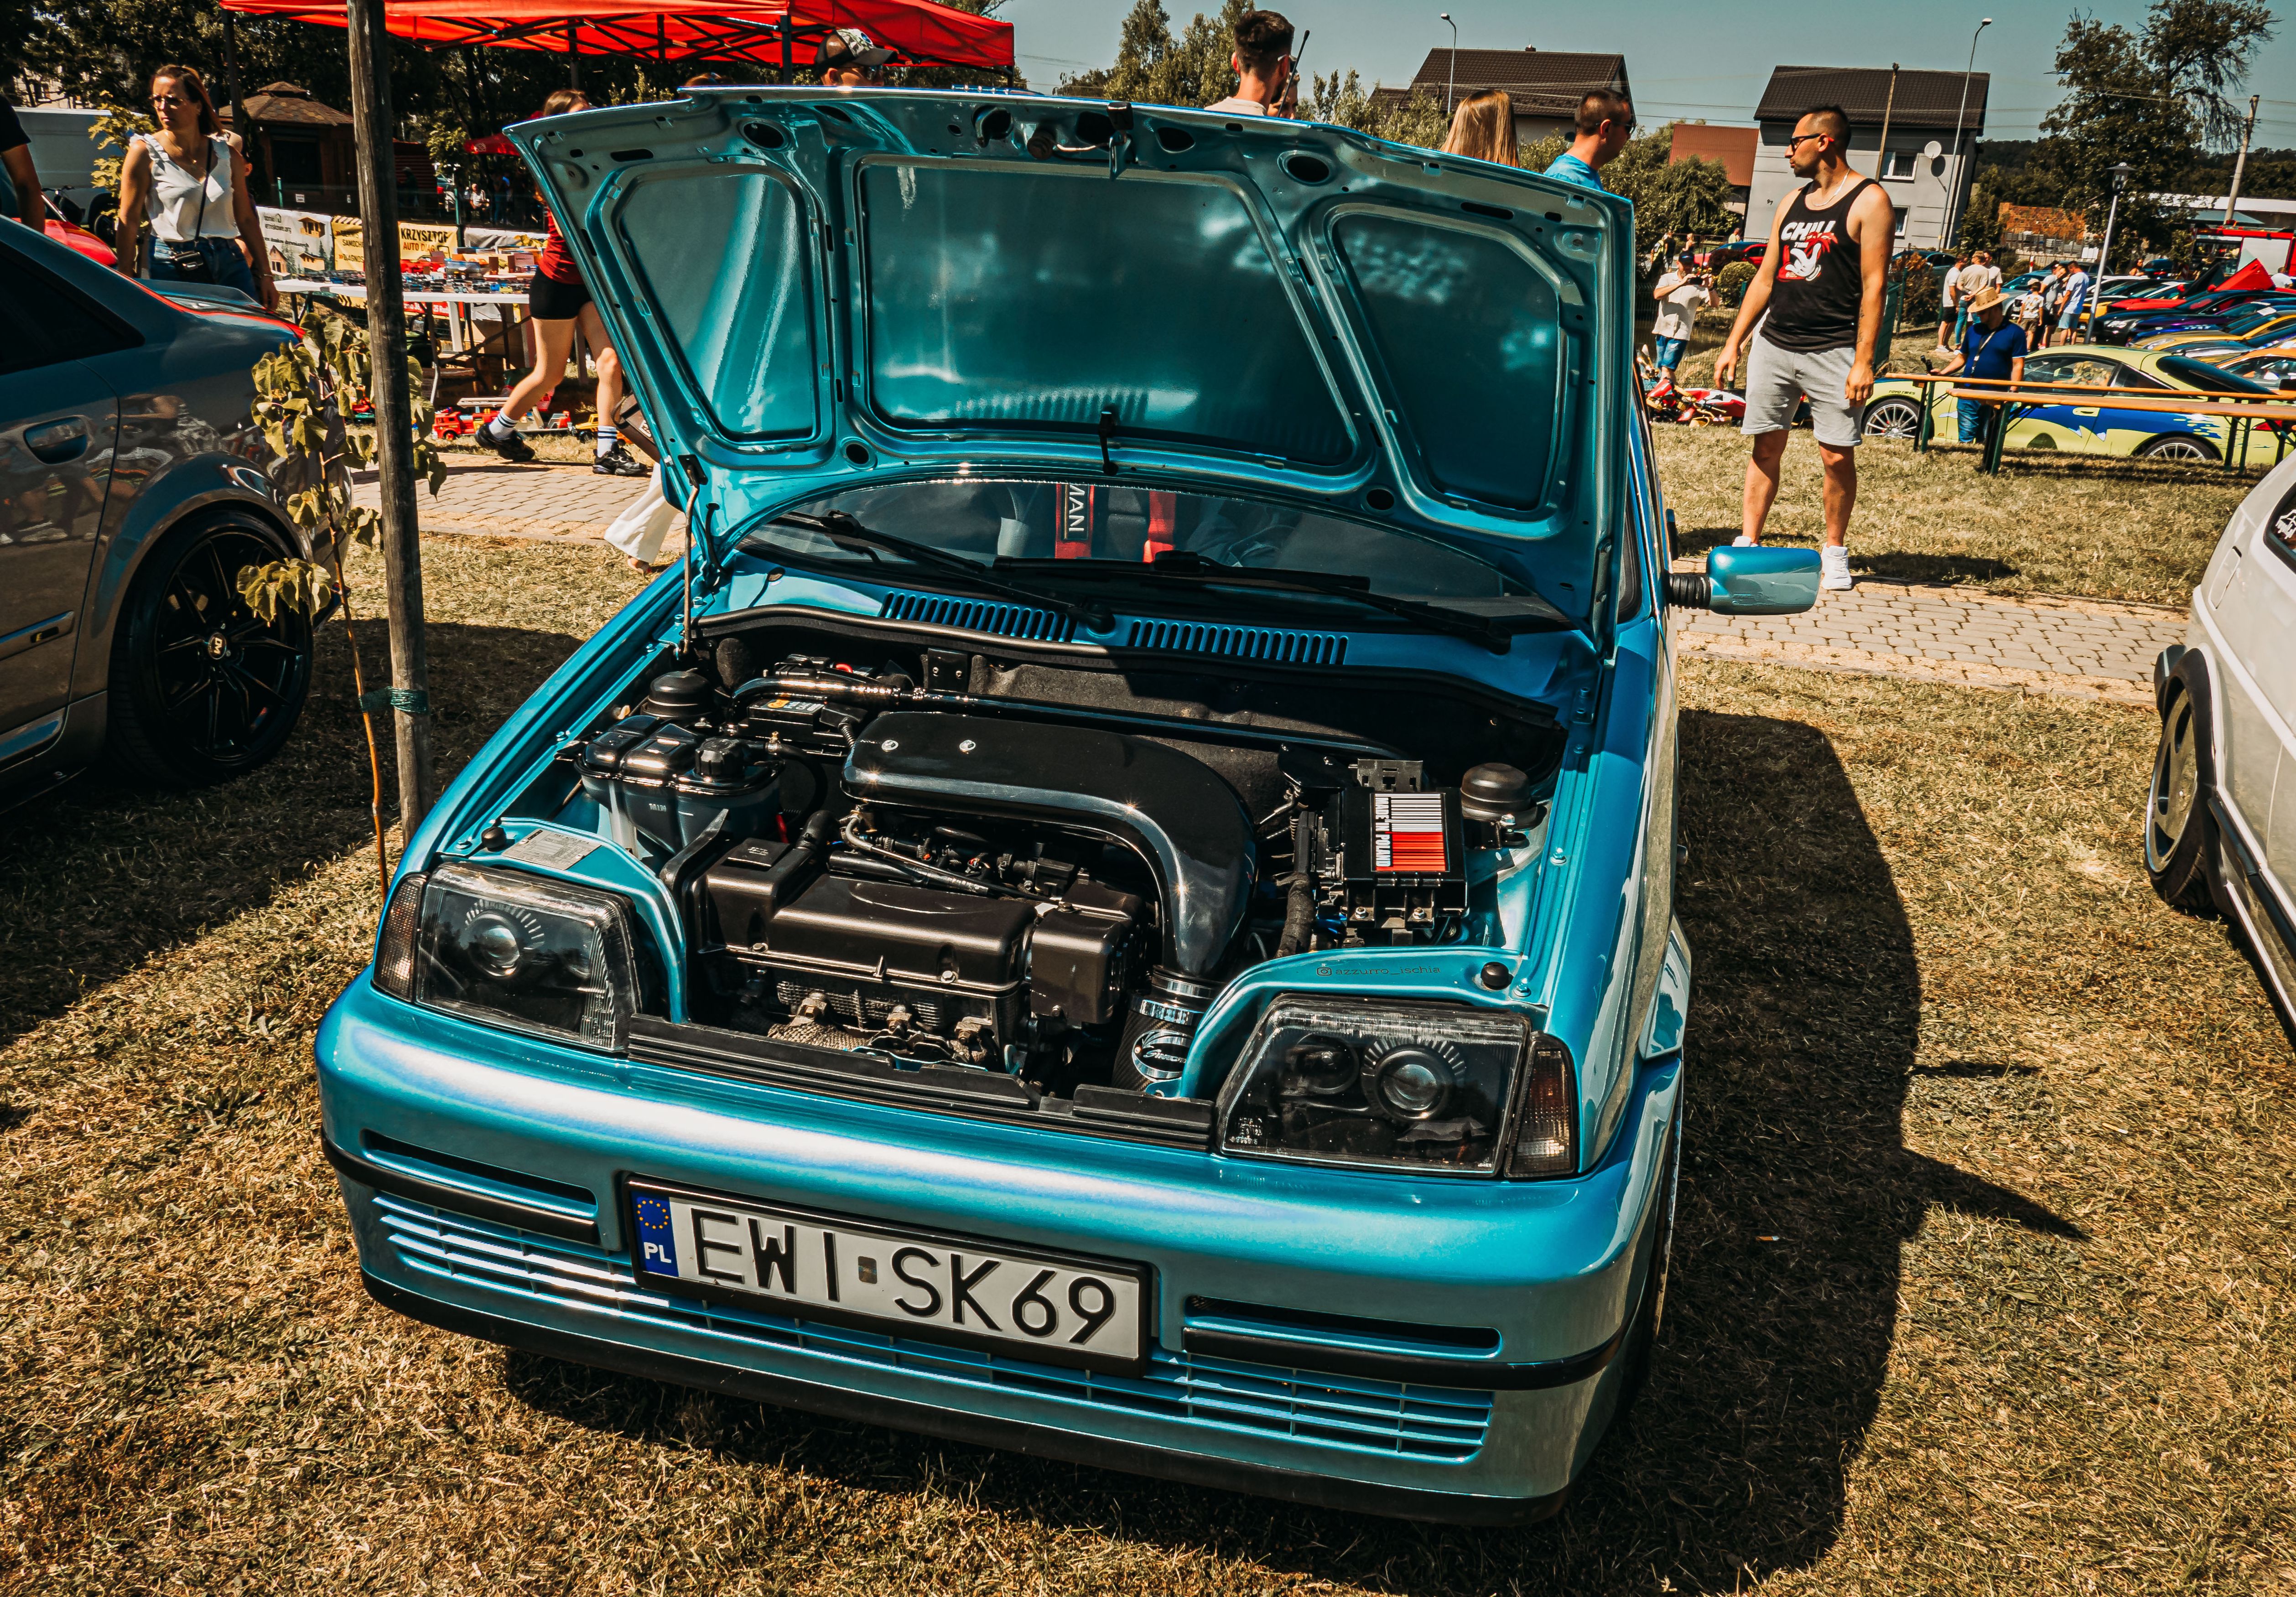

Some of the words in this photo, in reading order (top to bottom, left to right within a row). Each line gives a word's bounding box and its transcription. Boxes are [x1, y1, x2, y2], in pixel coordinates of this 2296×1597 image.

[1781, 220, 1836, 240] CHILL
[403, 242, 419, 251] AUTO
[343, 254, 364, 263] DIAGNOS
[1375, 797, 1389, 819] MADE
[1375, 822, 1390, 831] IN
[1375, 834, 1391, 867] POLAND
[1335, 966, 1441, 975] azzurro_ischia
[1143, 1049, 1186, 1063] SIMOT
[644, 1242, 671, 1263] PL
[690, 1208, 840, 1303] EWI
[891, 1246, 1116, 1345] SK69
